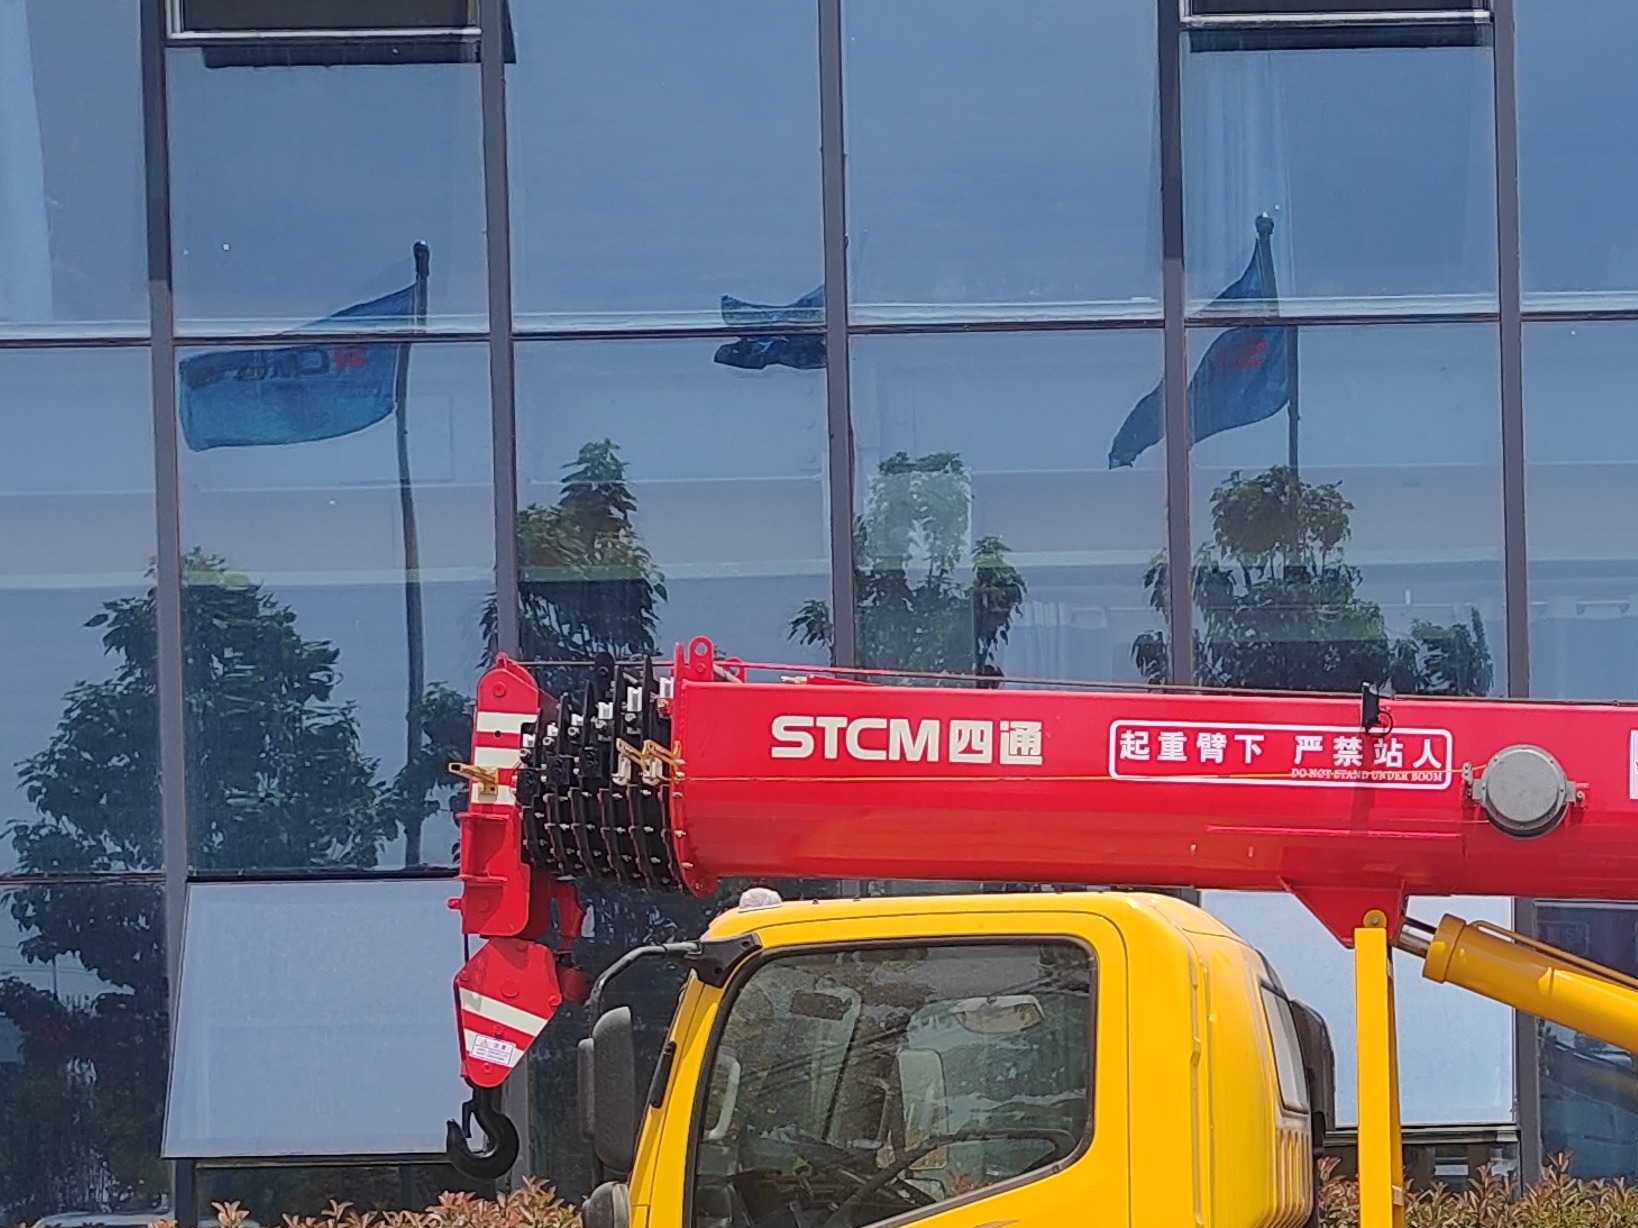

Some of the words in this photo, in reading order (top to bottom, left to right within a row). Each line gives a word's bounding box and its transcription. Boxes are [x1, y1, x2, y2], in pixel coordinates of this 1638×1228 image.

[1119, 730, 1264, 764] 起重臂下
[1294, 735, 1443, 769] 严禁站人
[1291, 768, 1306, 778] DO
[1309, 768, 1331, 779] NOT
[1335, 769, 1369, 780] STAND
[1371, 770, 1409, 781] UNDER
[1411, 771, 1443, 782] BOOM
